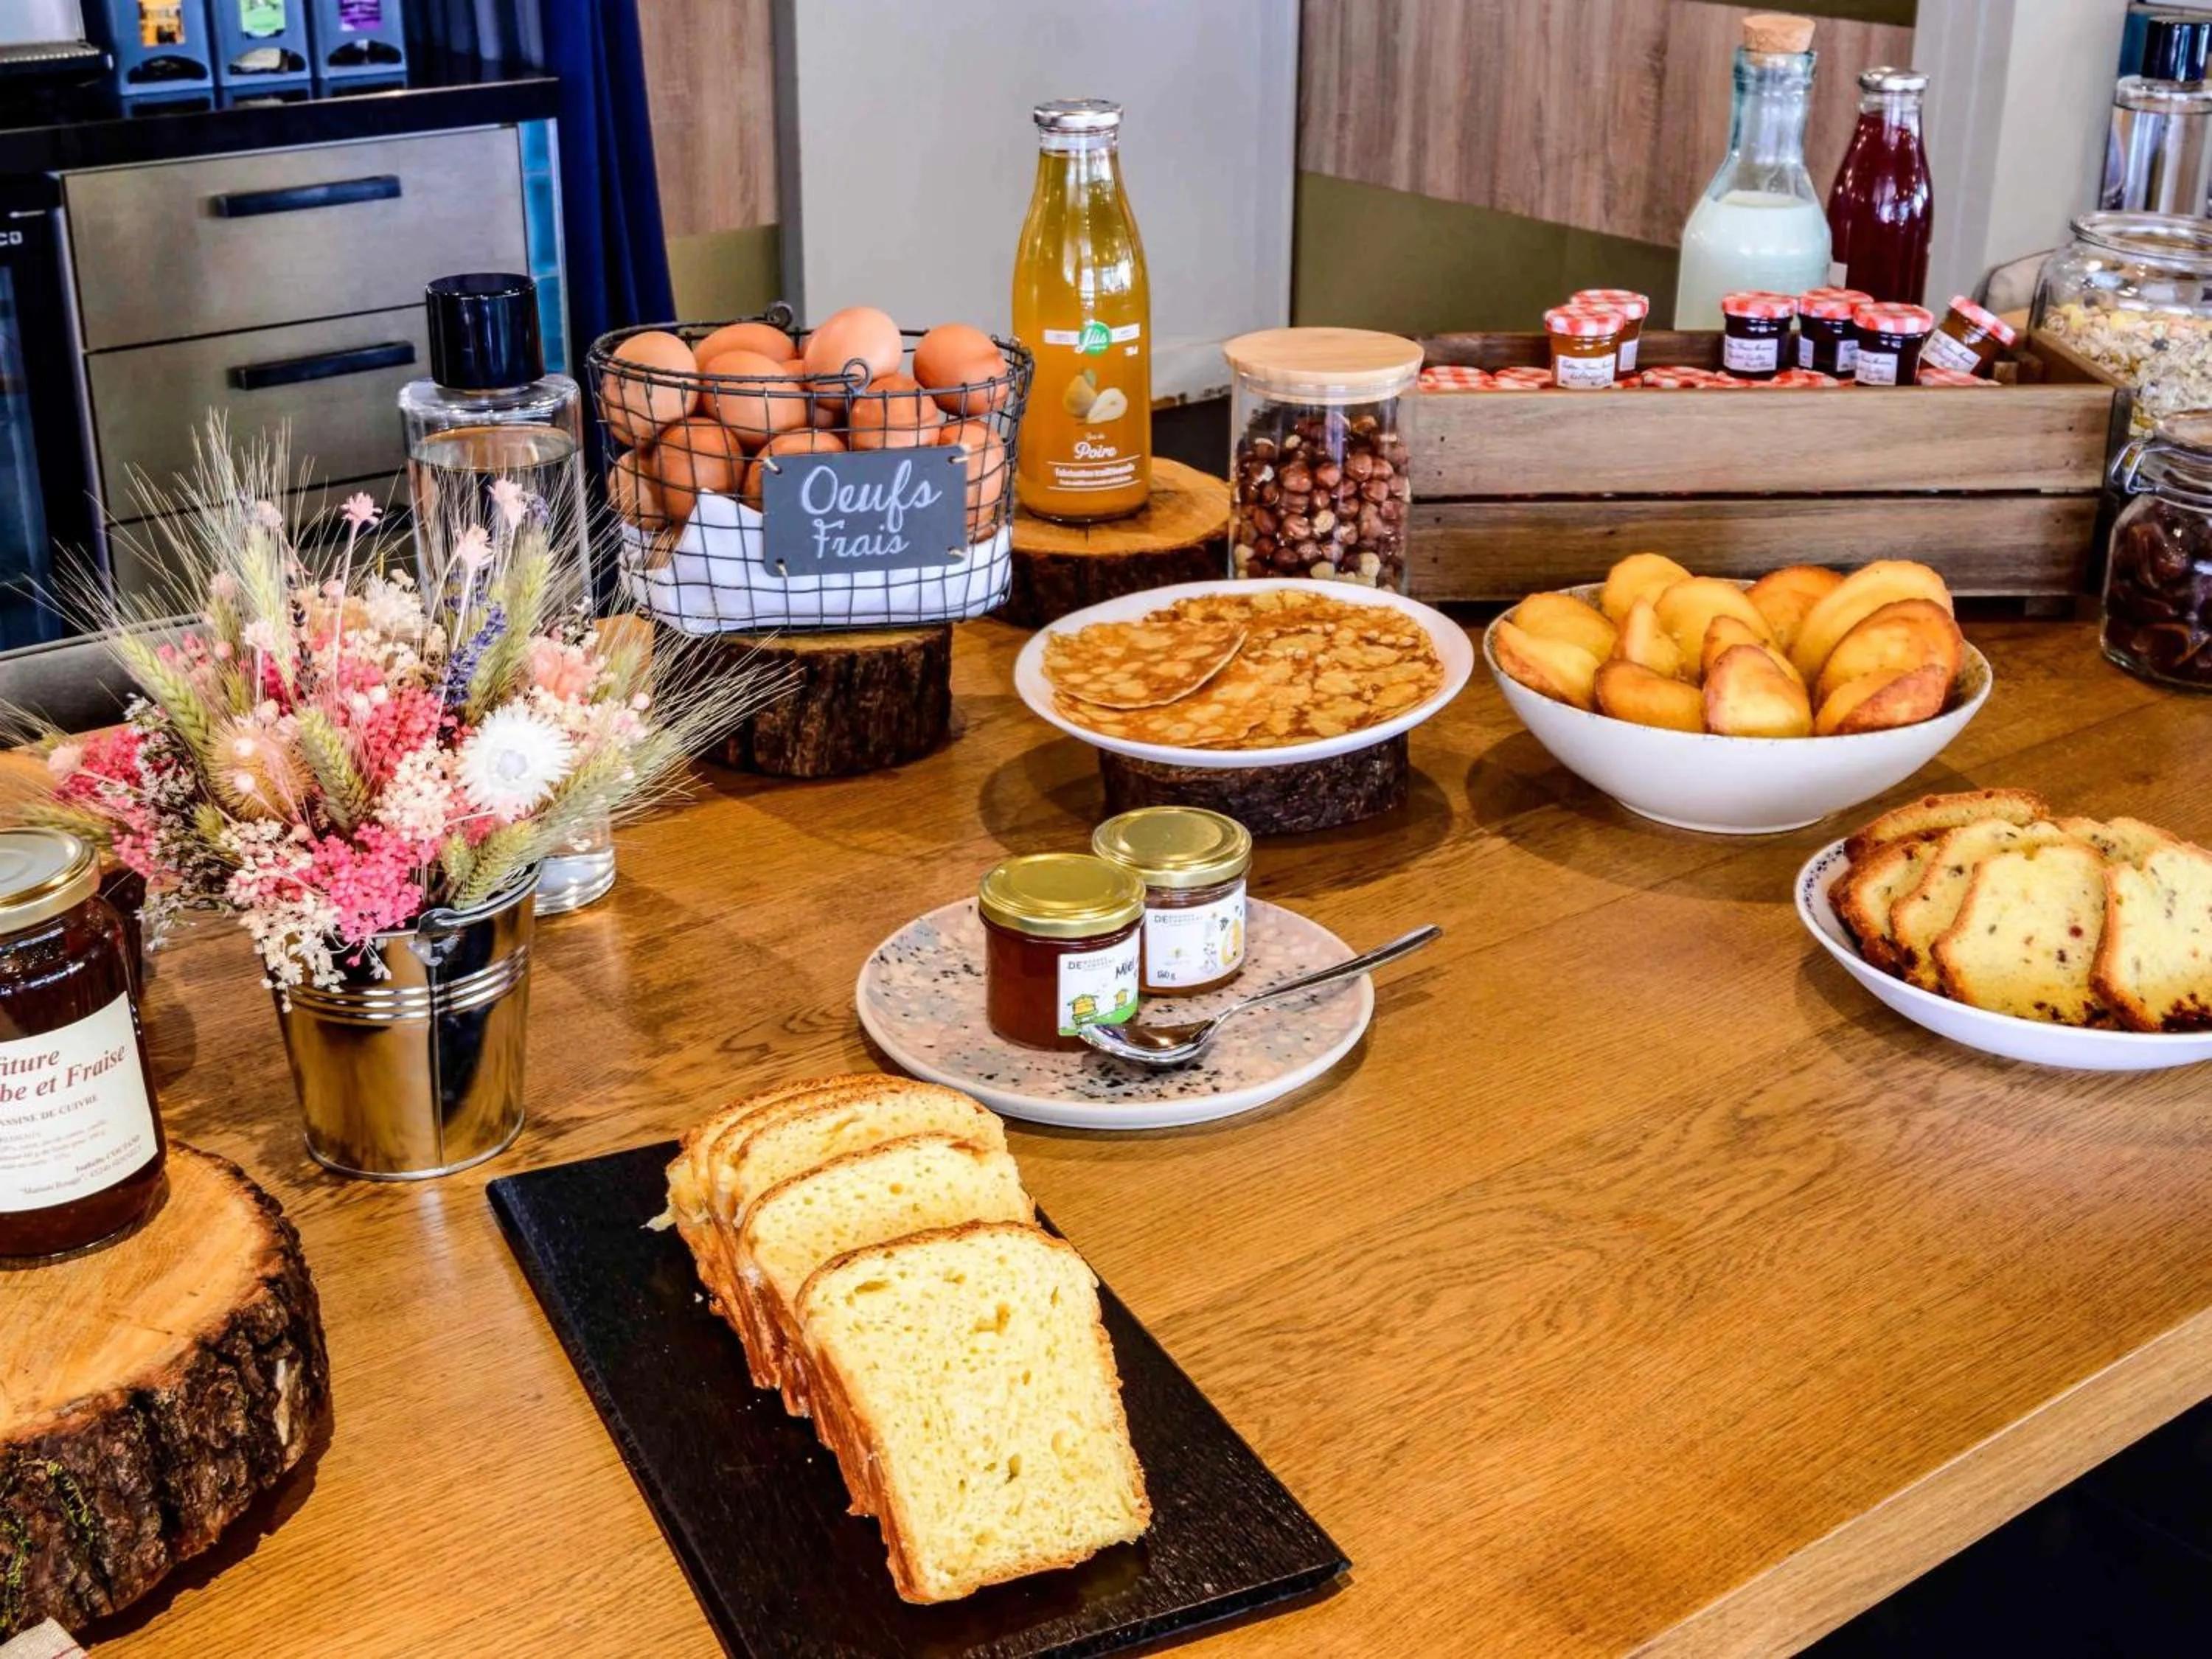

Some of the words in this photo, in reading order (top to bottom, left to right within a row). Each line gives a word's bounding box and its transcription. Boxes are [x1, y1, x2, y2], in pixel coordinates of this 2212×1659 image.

[801, 459, 942, 533] Oeufs
[813, 518, 911, 560] Frais
[35, 1076, 58, 1097] et
[63, 1045, 126, 1088] Fraise
[58, 1094, 99, 1115] CUIVRE
